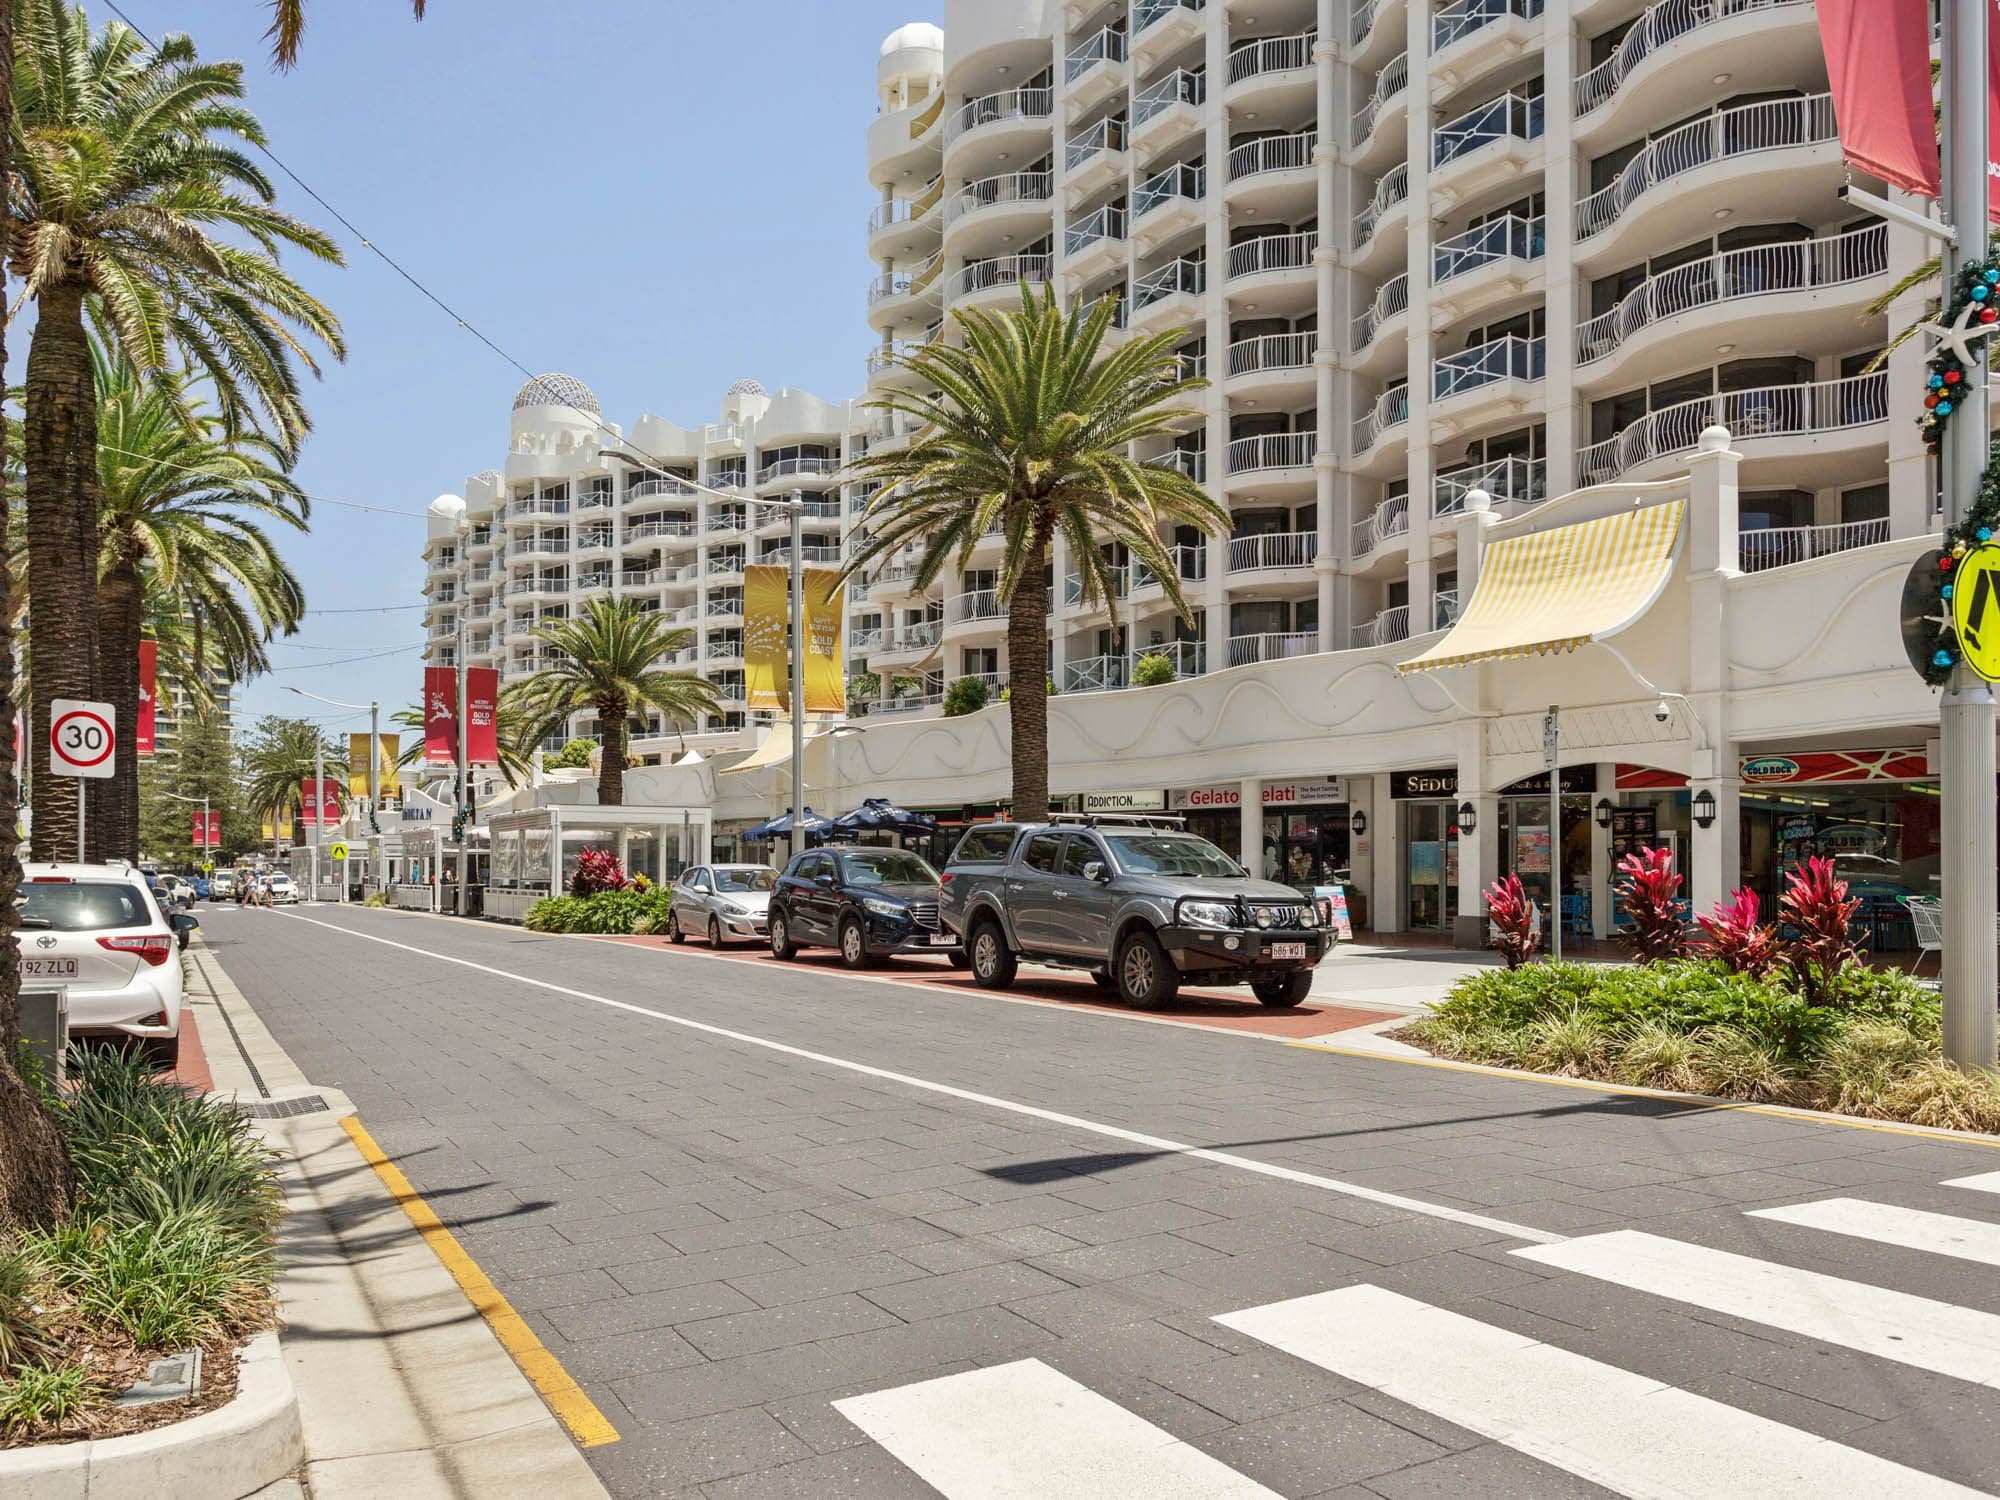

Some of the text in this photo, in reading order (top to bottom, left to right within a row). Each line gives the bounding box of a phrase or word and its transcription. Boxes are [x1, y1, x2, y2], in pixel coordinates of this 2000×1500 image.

[811, 636, 833, 645] GOLD
[809, 646, 834, 655] COAST
[65, 725, 102, 750] 30
[1747, 766, 1792, 775] COLD ROCK
[1190, 788, 1240, 805] Gelato
[1262, 785, 1296, 801] elati
[1087, 795, 1133, 808] ADDICTION
